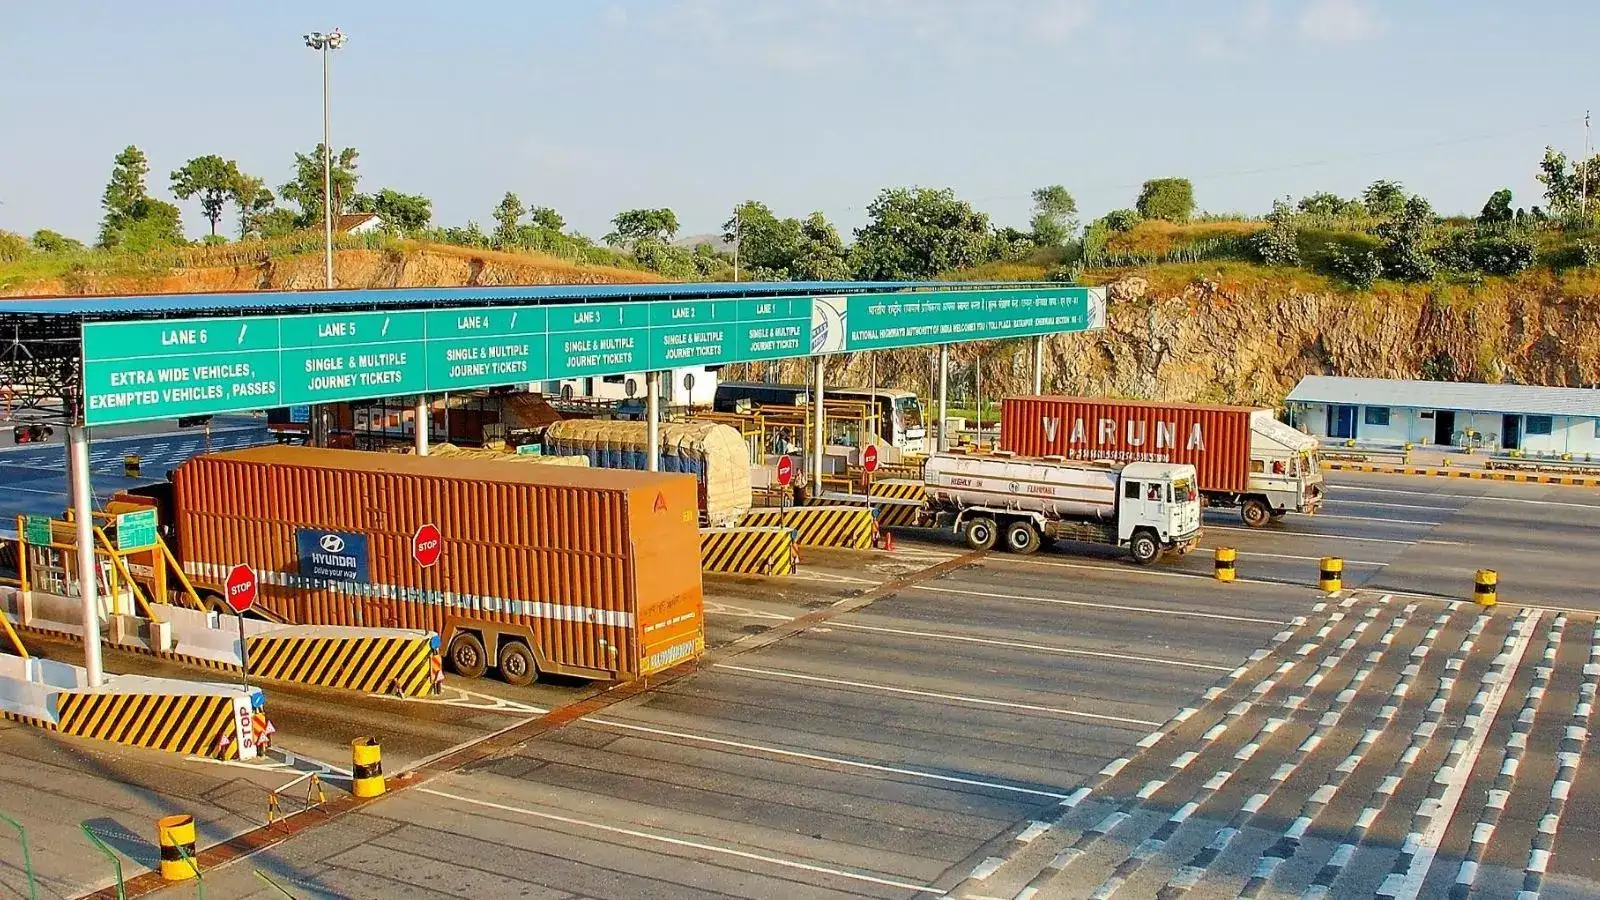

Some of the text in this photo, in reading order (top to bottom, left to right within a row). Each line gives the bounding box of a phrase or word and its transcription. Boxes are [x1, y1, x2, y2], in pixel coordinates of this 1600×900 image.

[672, 308, 688, 318] LANE
[756, 304, 772, 314] LANE
[458, 316, 480, 330] LANE
[574, 312, 594, 324] LANE
[318, 322, 346, 336] LANE
[750, 328, 768, 338] SINGLE
[774, 326, 800, 336] MULTIPLE
[852, 330, 879, 341] NATIONAL
[162, 330, 196, 344] LANE
[664, 334, 686, 344] SINGLE
[694, 332, 722, 342] MULTIPLE
[446, 348, 478, 360] SINGLE
[488, 344, 528, 358] MULTIPLE
[564, 340, 590, 352] SINGLE
[600, 338, 634, 350] MULTIPLE
[666, 346, 722, 358] JOURNEY TICKETS
[750, 338, 798, 352] JOURNEY TICKETS
[306, 358, 342, 372] SINGLE
[358, 352, 406, 368] MULTIPLE
[566, 352, 632, 366] JOURNEY TICKETS
[110, 364, 254, 386] EXTRA WIDE VEHICLES,
[450, 360, 526, 376] JOURNEY TICKETS
[308, 370, 402, 390] JOURNEY TICKETS
[90, 390, 160, 410] EXEMPTED
[162, 384, 222, 402] VEHICLES
[232, 382, 276, 396] PASSES
[1042, 416, 1206, 450] VARUNA
[418, 540, 437, 552] STOP
[312, 553, 356, 568] HYUNDAI
[314, 566, 357, 579] Drive your way
[231, 581, 252, 595] STOP
[240, 706, 252, 749] STOP
